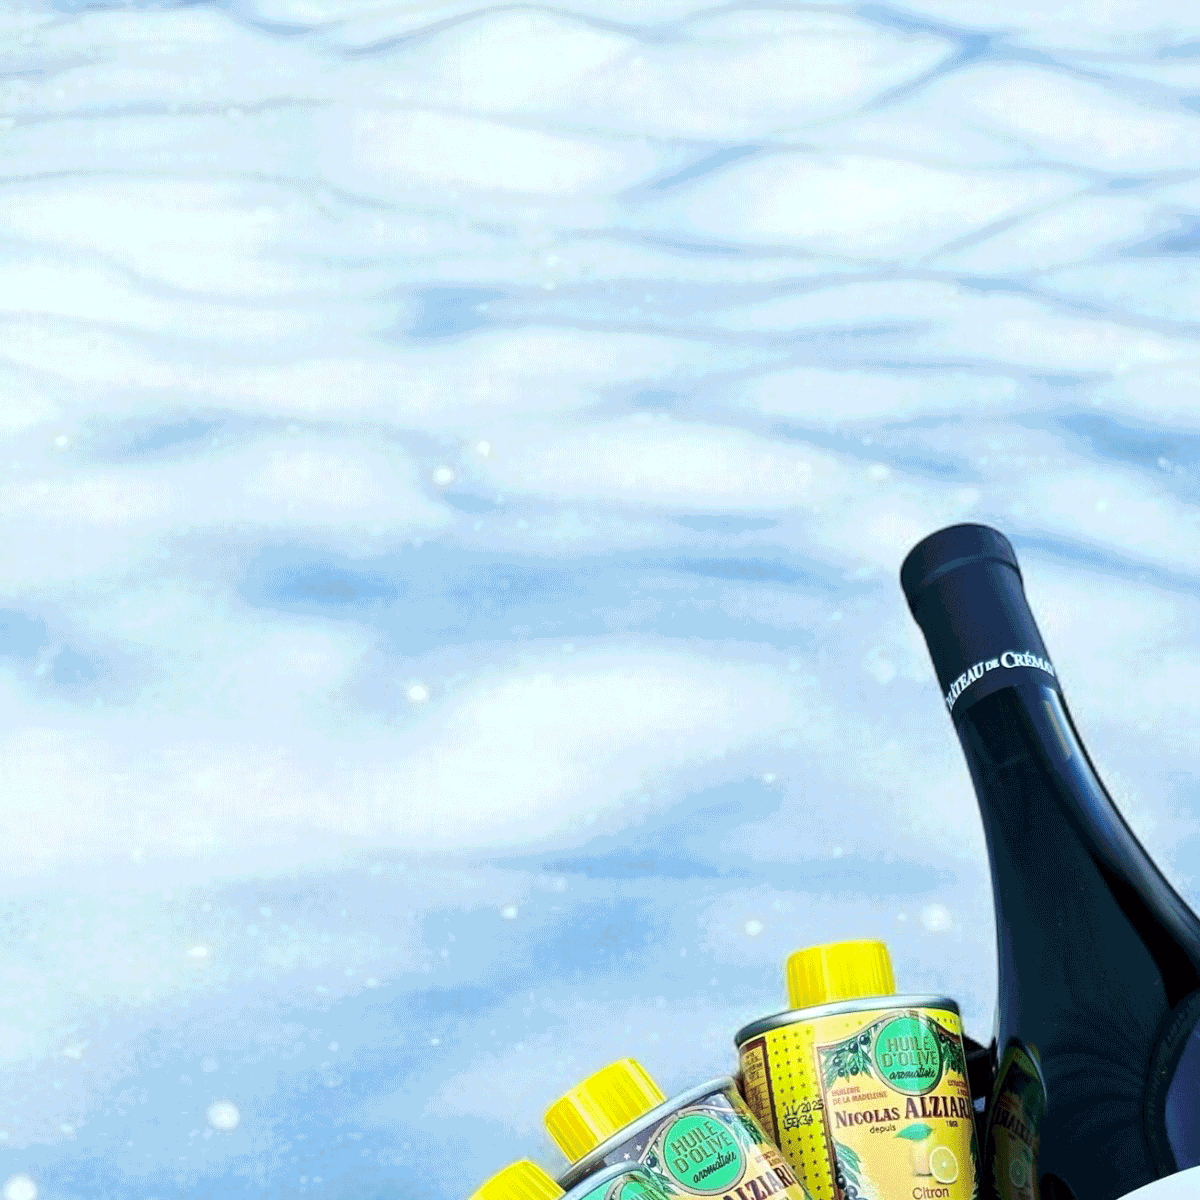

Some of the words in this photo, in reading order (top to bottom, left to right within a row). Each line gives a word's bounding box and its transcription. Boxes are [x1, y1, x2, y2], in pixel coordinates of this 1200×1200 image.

[886, 1035, 931, 1053] HUILE
[881, 1050, 937, 1068] D'OLIVE
[832, 1097, 842, 1105] DE
[842, 1096, 851, 1104] LA
[851, 1091, 887, 1102] MADELEINE
[835, 1107, 901, 1129] NICOLAS
[869, 1124, 897, 1134] depuis
[670, 1120, 718, 1157] HUILE
[673, 1131, 733, 1174] D'OLIVE
[912, 1186, 950, 1200] Citron
